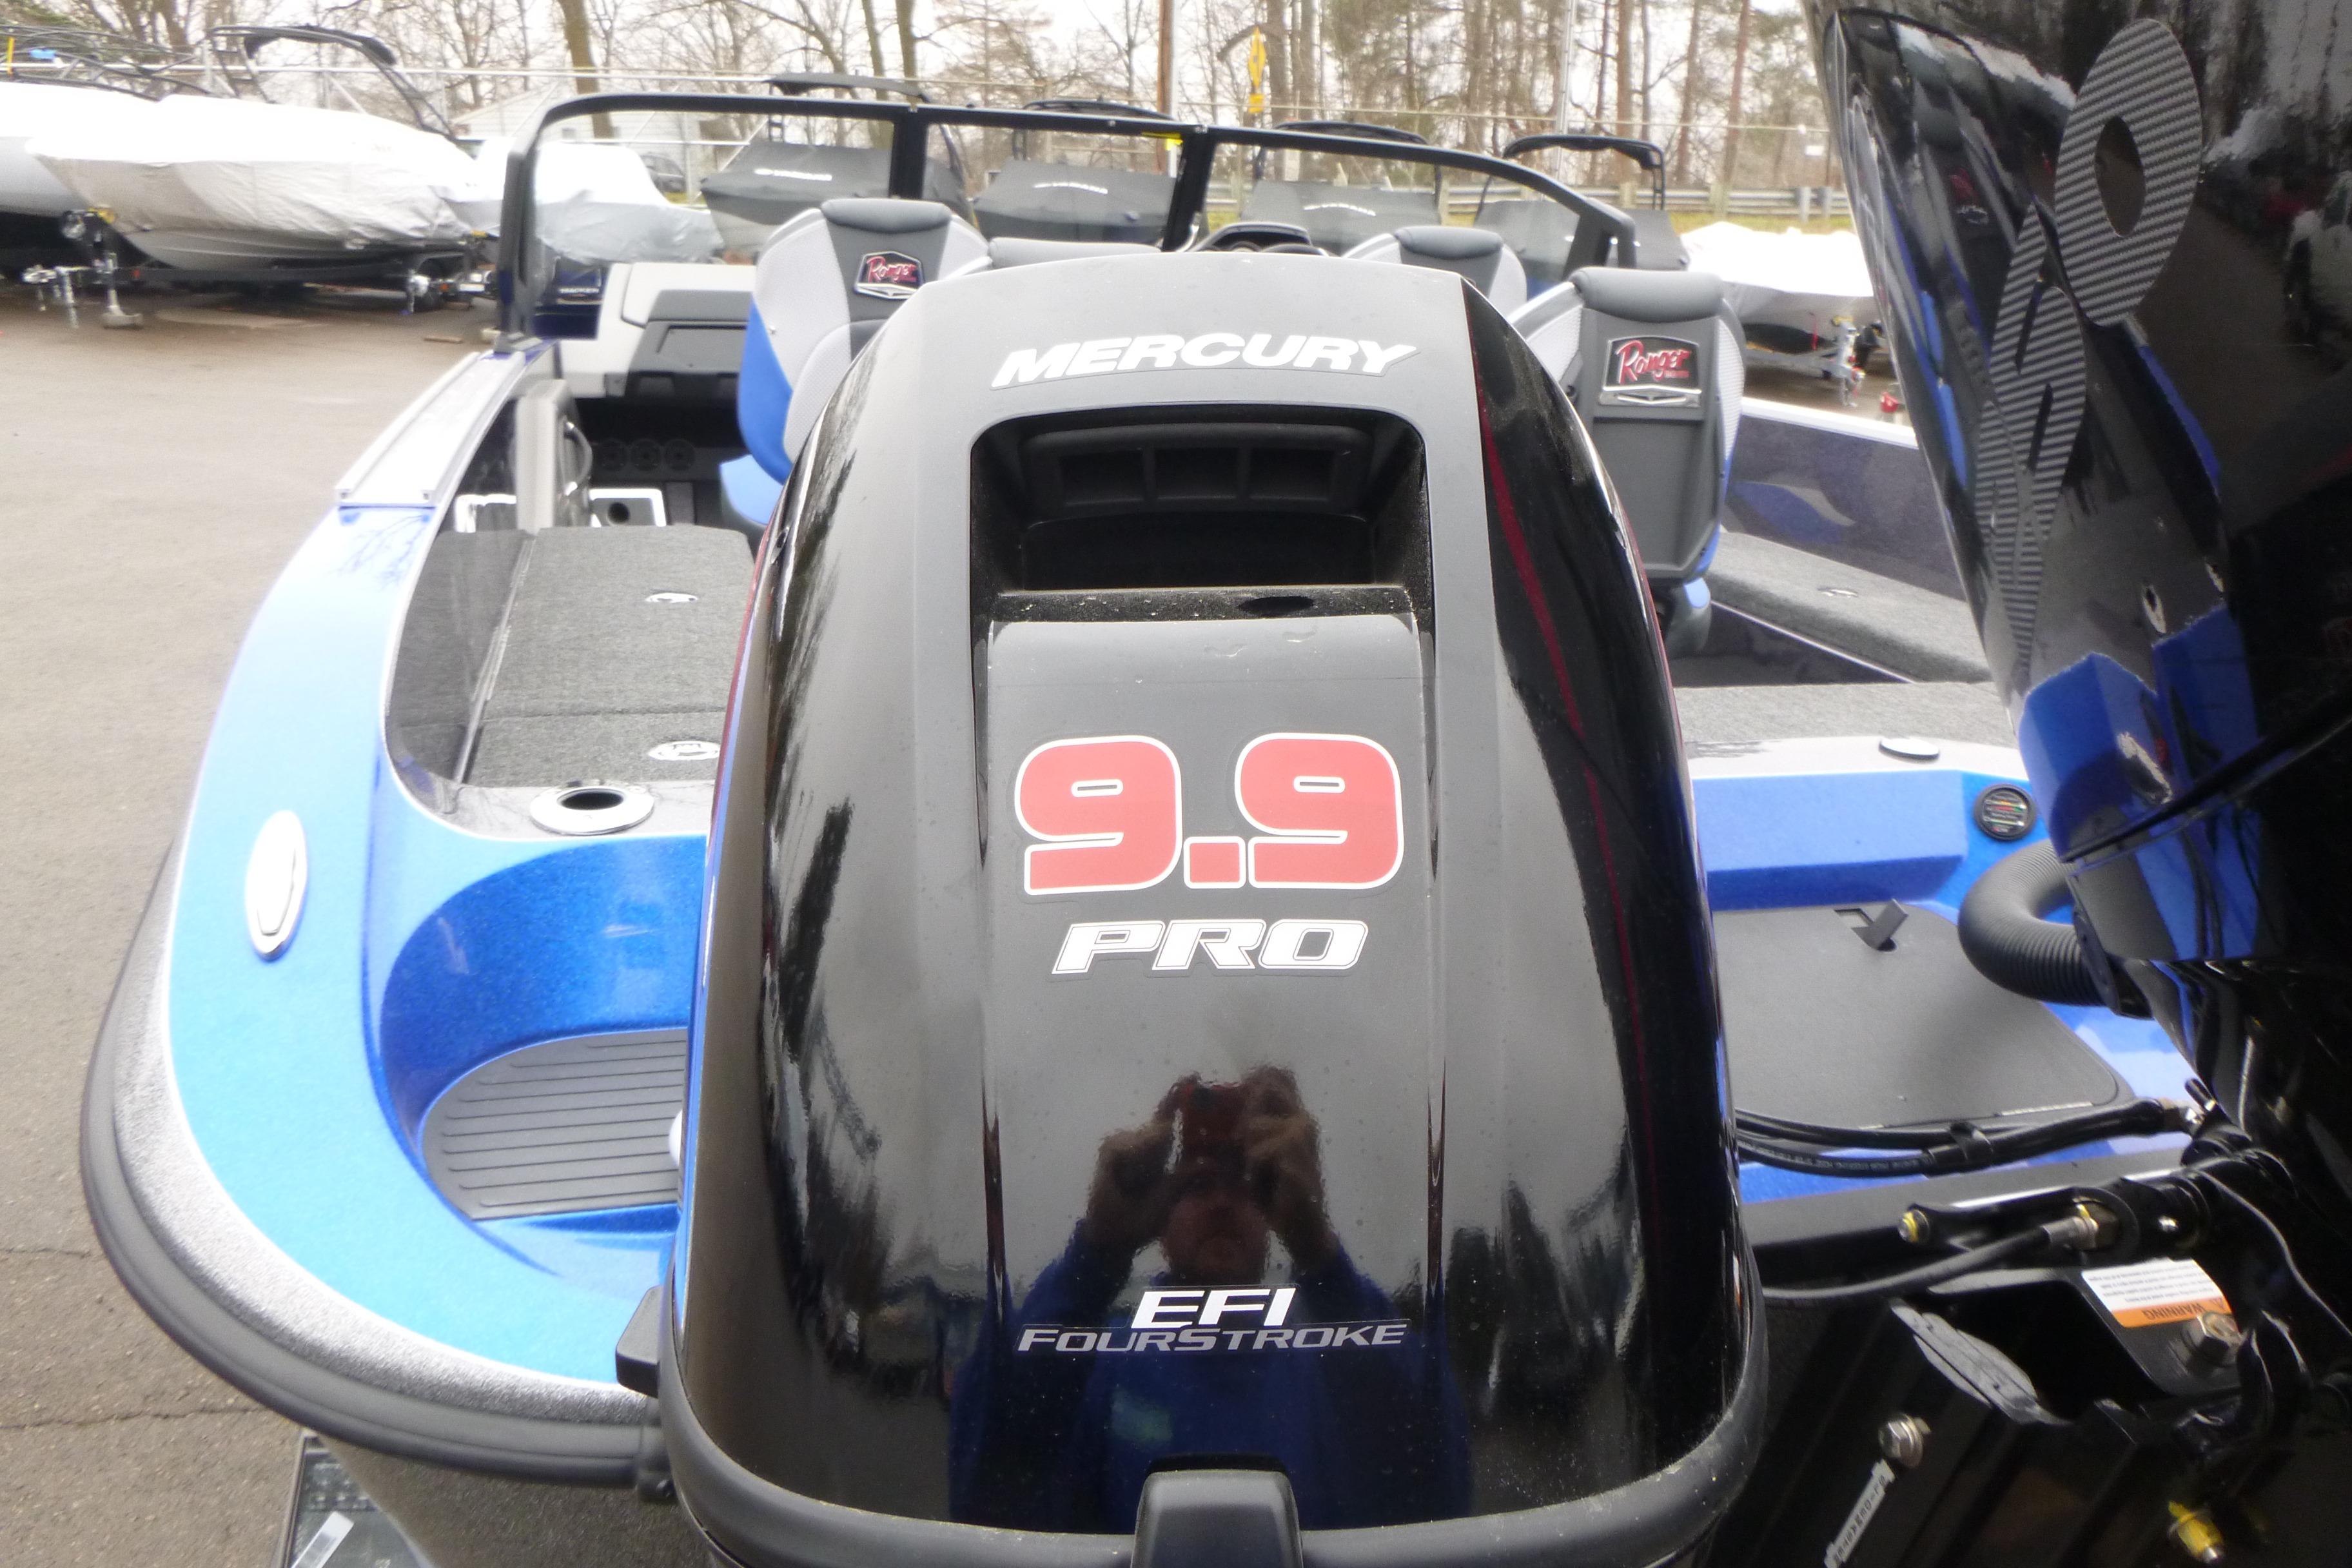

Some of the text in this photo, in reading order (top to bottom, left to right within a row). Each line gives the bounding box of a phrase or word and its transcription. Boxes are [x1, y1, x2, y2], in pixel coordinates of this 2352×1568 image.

[991, 333, 1417, 387] MERCURY
[1616, 340, 1692, 385] Ranger
[1014, 732, 1404, 896] 9.9
[1052, 919, 1369, 974] PRO
[1131, 1288, 1297, 1329] EFI
[2142, 1302, 2206, 1320] WARNING
[1017, 1324, 1407, 1353] FOURSTROKE
